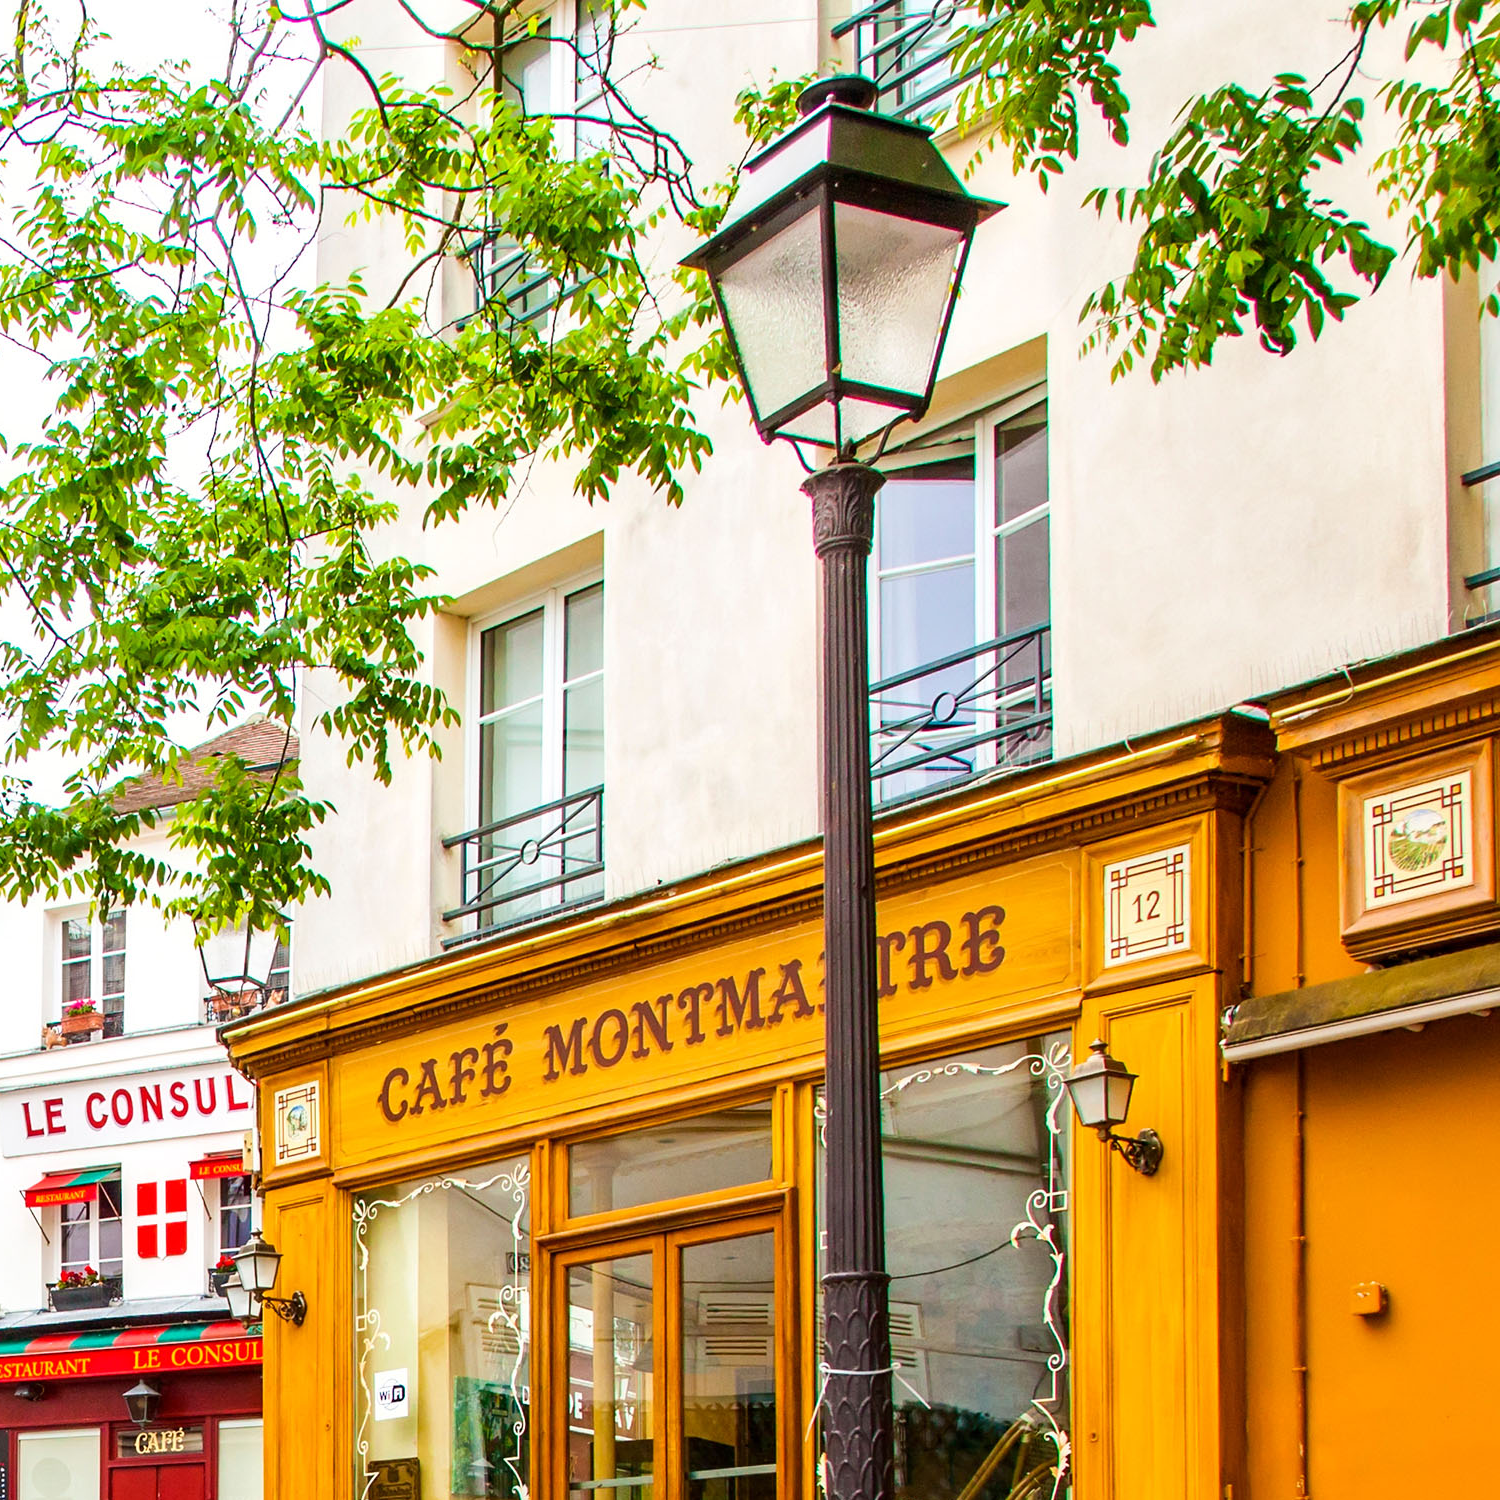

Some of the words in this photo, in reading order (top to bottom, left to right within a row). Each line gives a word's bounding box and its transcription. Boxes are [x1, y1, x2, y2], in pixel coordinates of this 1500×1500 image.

[1131, 890, 1161, 924] 12
[380, 1023, 513, 1122] CAFÉ
[543, 904, 1006, 1083] MONTMATRE
[21, 1097, 67, 1139] LE
[85, 1074, 255, 1130] CONSUL
[198, 1166, 210, 1176] LE
[35, 1189, 86, 1204] RESTAURANT
[133, 1348, 162, 1370] LE
[134, 1426, 186, 1455] CAFÉ
